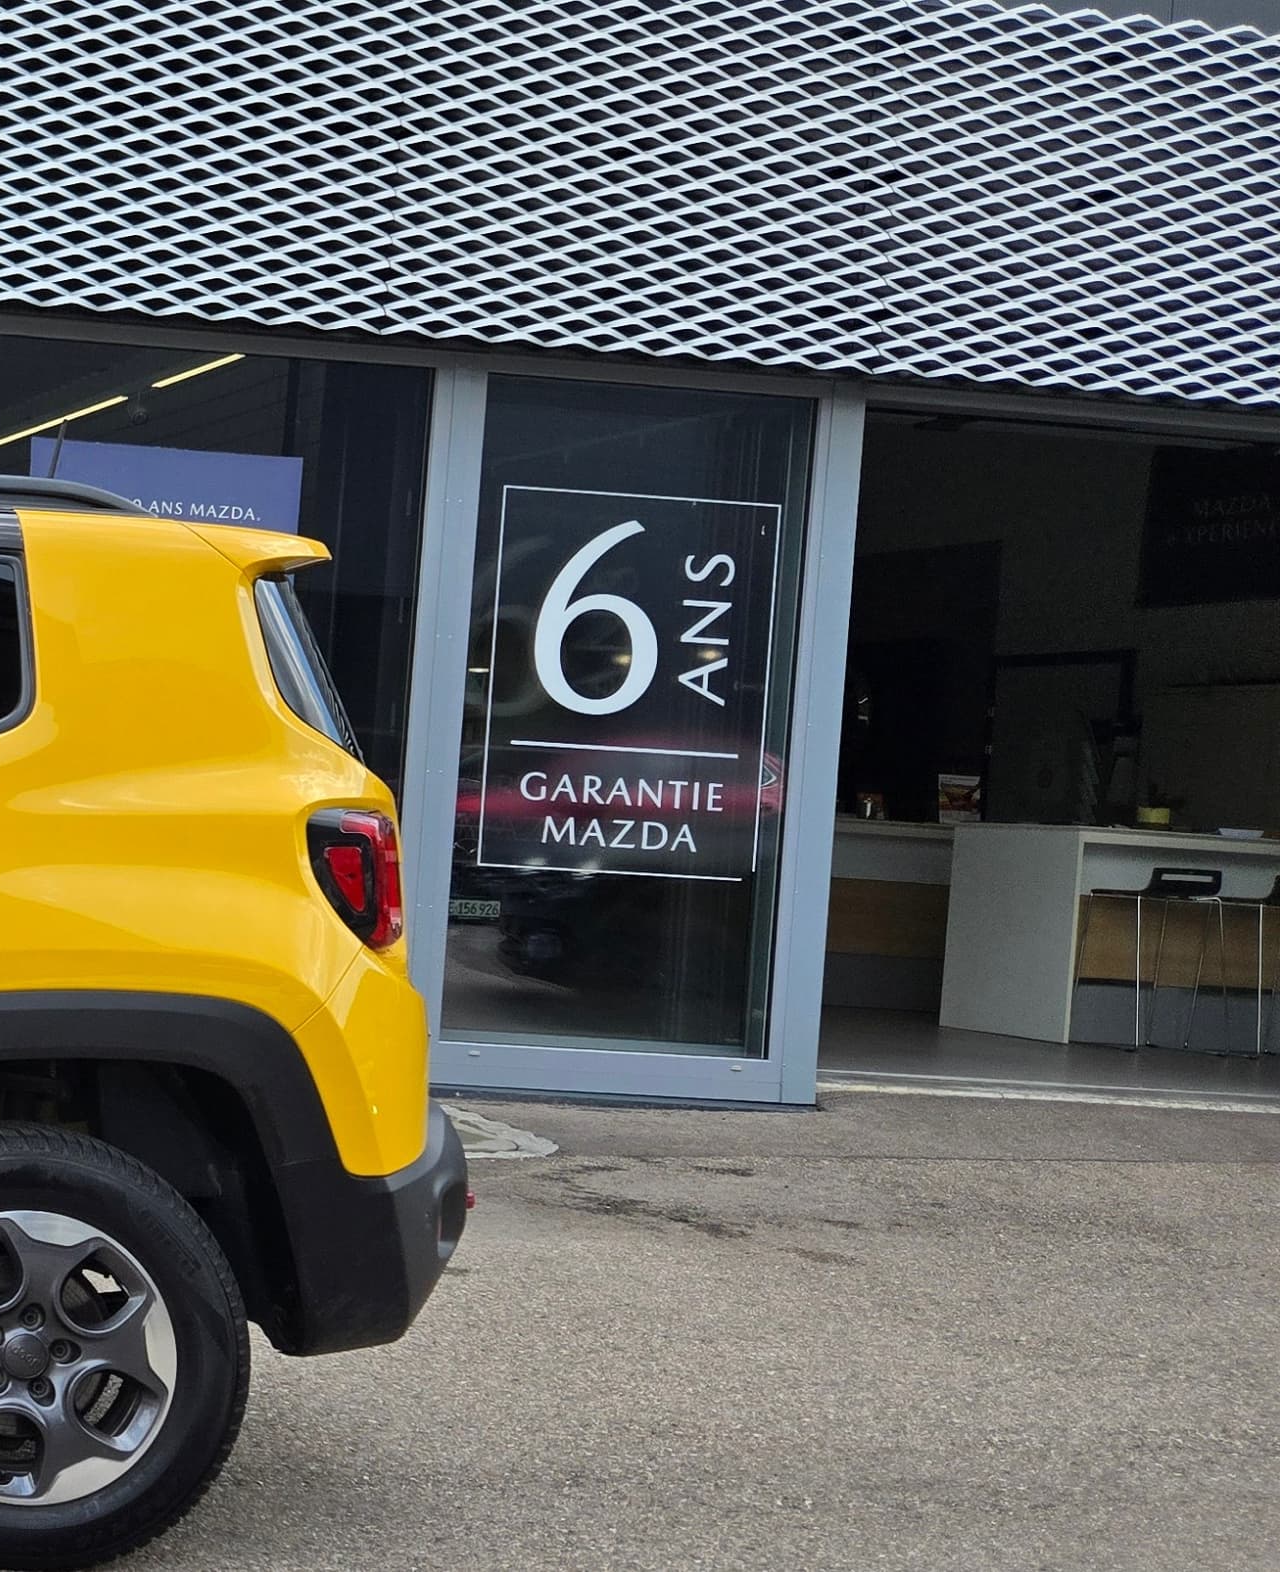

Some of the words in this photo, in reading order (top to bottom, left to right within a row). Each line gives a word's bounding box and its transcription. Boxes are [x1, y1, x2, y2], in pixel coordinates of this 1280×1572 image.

[148, 500, 183, 516] ANS
[189, 503, 261, 522] MAZDA.
[534, 519, 658, 715] 6
[678, 553, 736, 707] ANS
[519, 771, 724, 819] GARANTIE
[541, 815, 697, 853] MAZDA
